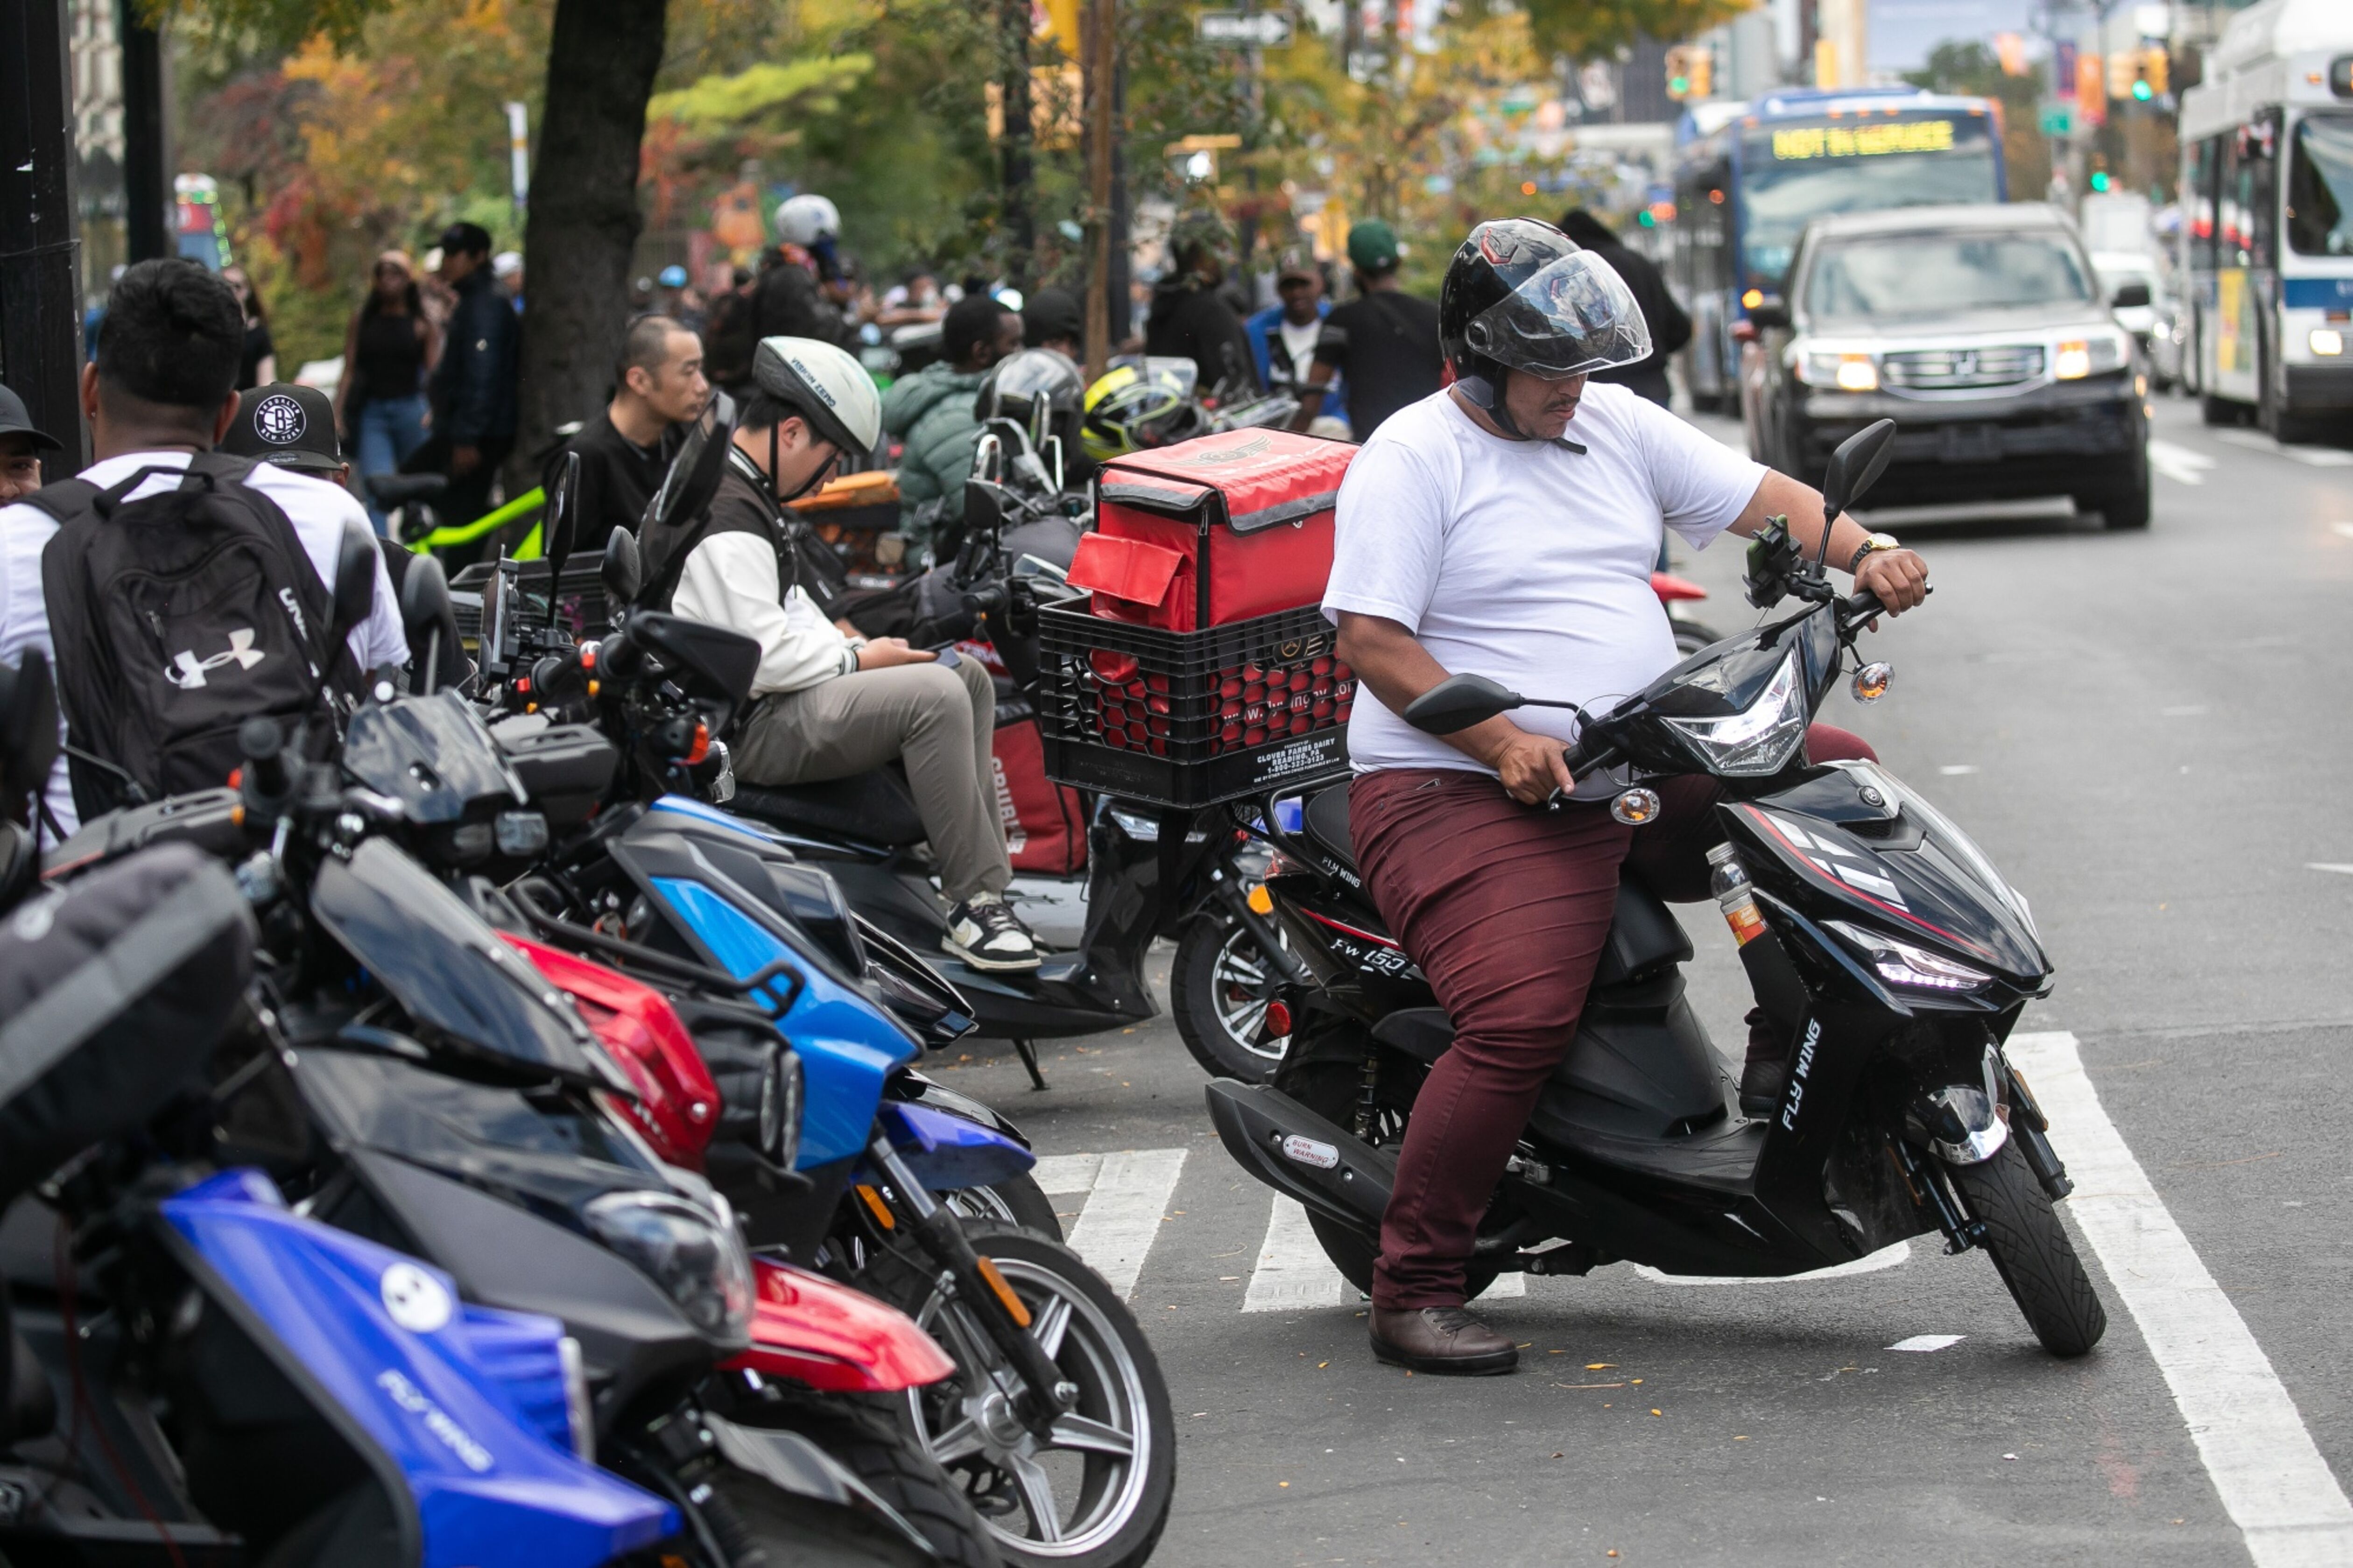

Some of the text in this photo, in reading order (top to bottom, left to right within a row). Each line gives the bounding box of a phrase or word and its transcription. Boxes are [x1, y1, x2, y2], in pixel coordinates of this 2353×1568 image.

[792, 358, 836, 407] VISION ZERO
[259, 399, 300, 415] BROOKLYN
[275, 408, 286, 431] B
[261, 427, 301, 441] NEW YORK
[1257, 738, 1335, 763] CLOVER FARMS DAIRY
[1322, 857, 1361, 887] FLY WING
[1364, 950, 1405, 970] 150
[1782, 1018, 1821, 1131] FLY WING
[1292, 1139, 1312, 1149] BURN
[1294, 1149, 1329, 1162] WARNING
